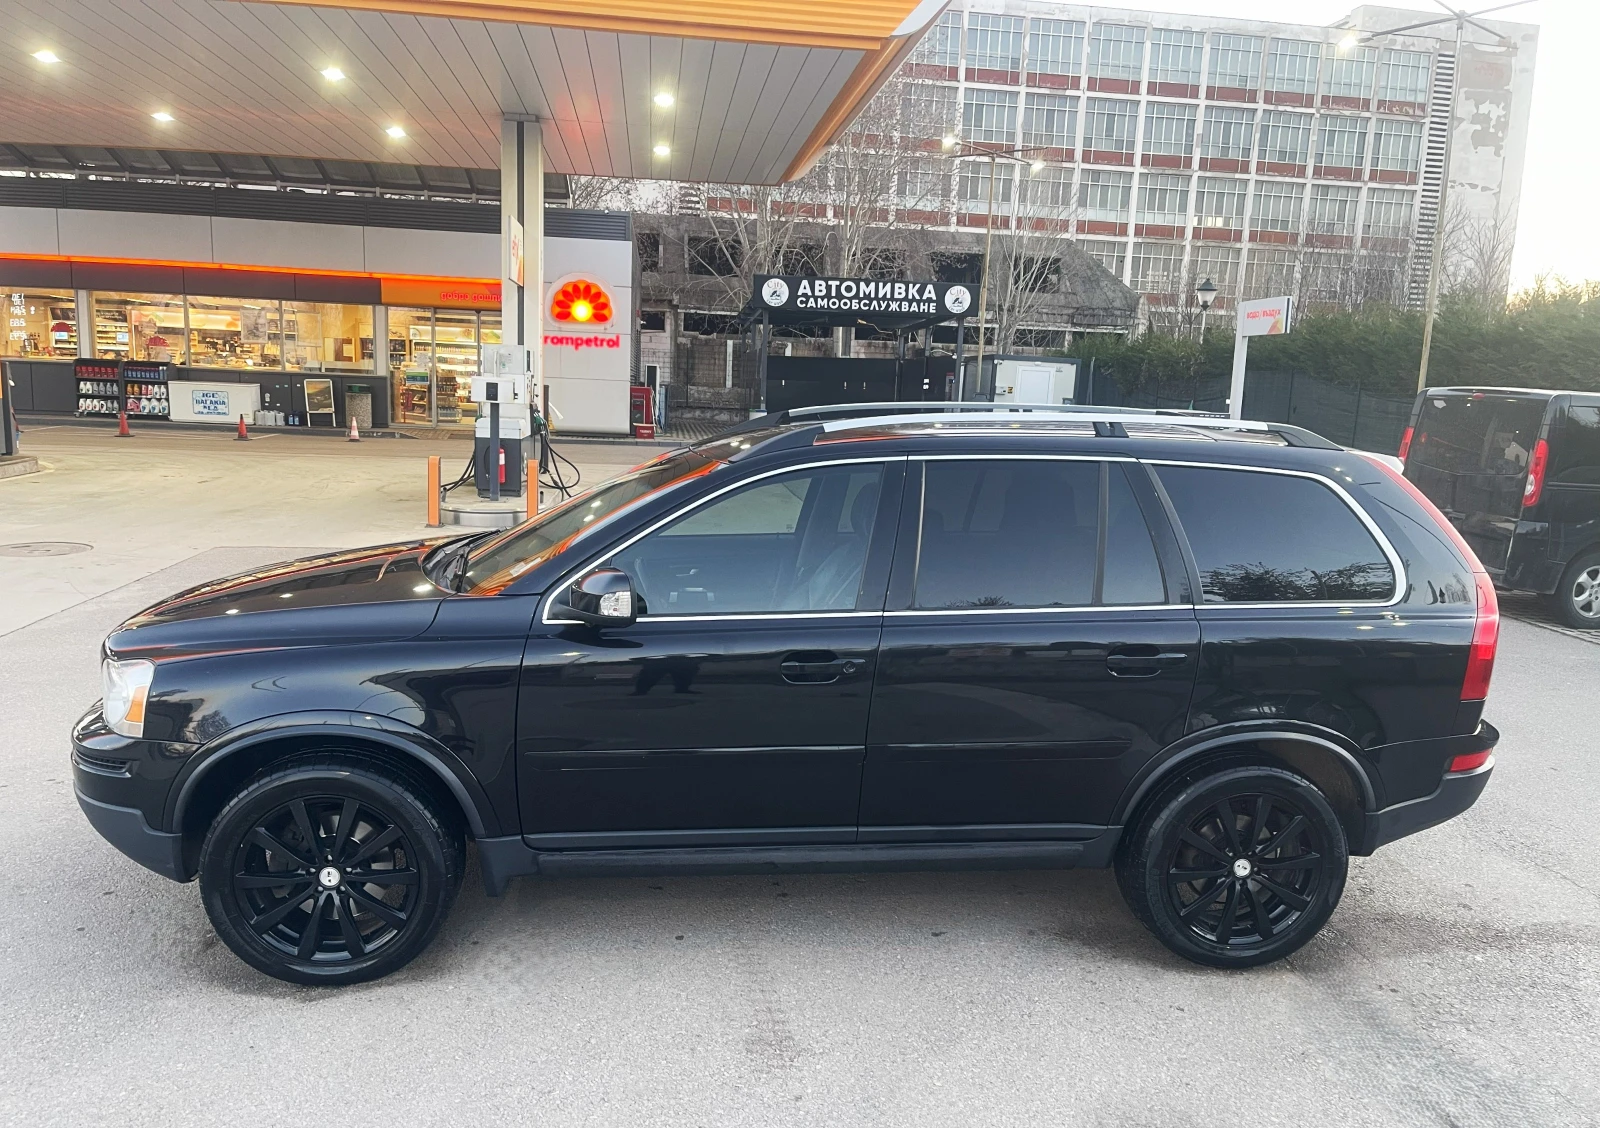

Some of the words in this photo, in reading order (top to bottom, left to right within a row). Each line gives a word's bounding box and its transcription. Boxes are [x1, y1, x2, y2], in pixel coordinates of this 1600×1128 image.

[797, 279, 937, 300] АВТОМИВКА
[796, 297, 937, 313] САМООБСЛУЖВАНЕ
[544, 334, 620, 350] rompetrol
